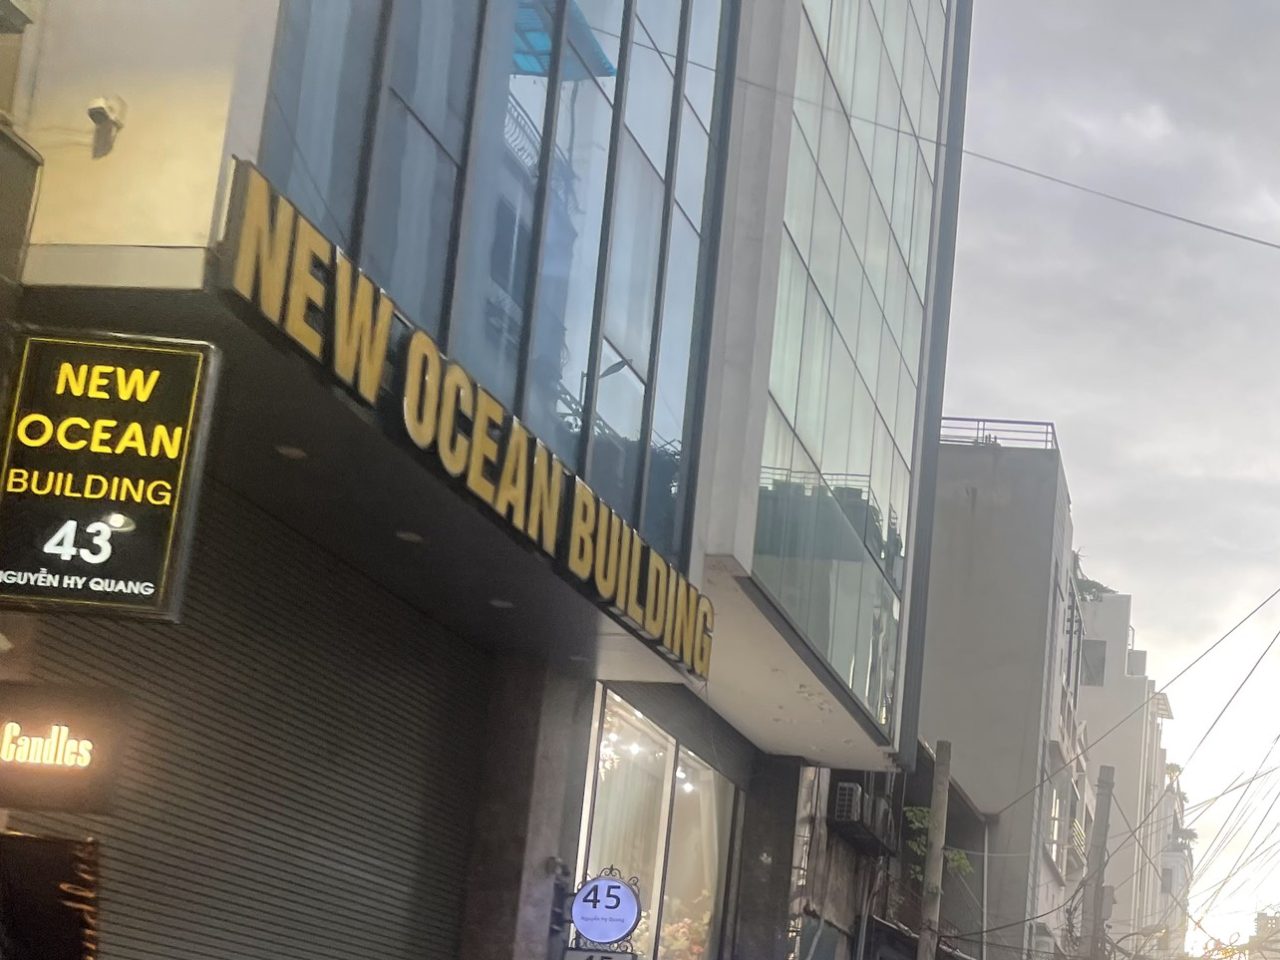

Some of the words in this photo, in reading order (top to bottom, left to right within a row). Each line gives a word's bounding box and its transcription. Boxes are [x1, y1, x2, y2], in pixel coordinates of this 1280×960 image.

[55, 362, 160, 402] NEW
[17, 413, 183, 459] OCEAN
[232, 162, 395, 406] NEW
[403, 330, 565, 559] OCEAN
[568, 475, 715, 680] BUILDING
[6, 468, 172, 506] BUILDING
[43, 518, 113, 564] 43
[62, 575, 87, 590] HY
[88, 577, 156, 597] QUANG
[0, 721, 93, 767] Candles
[582, 884, 621, 910] 45
